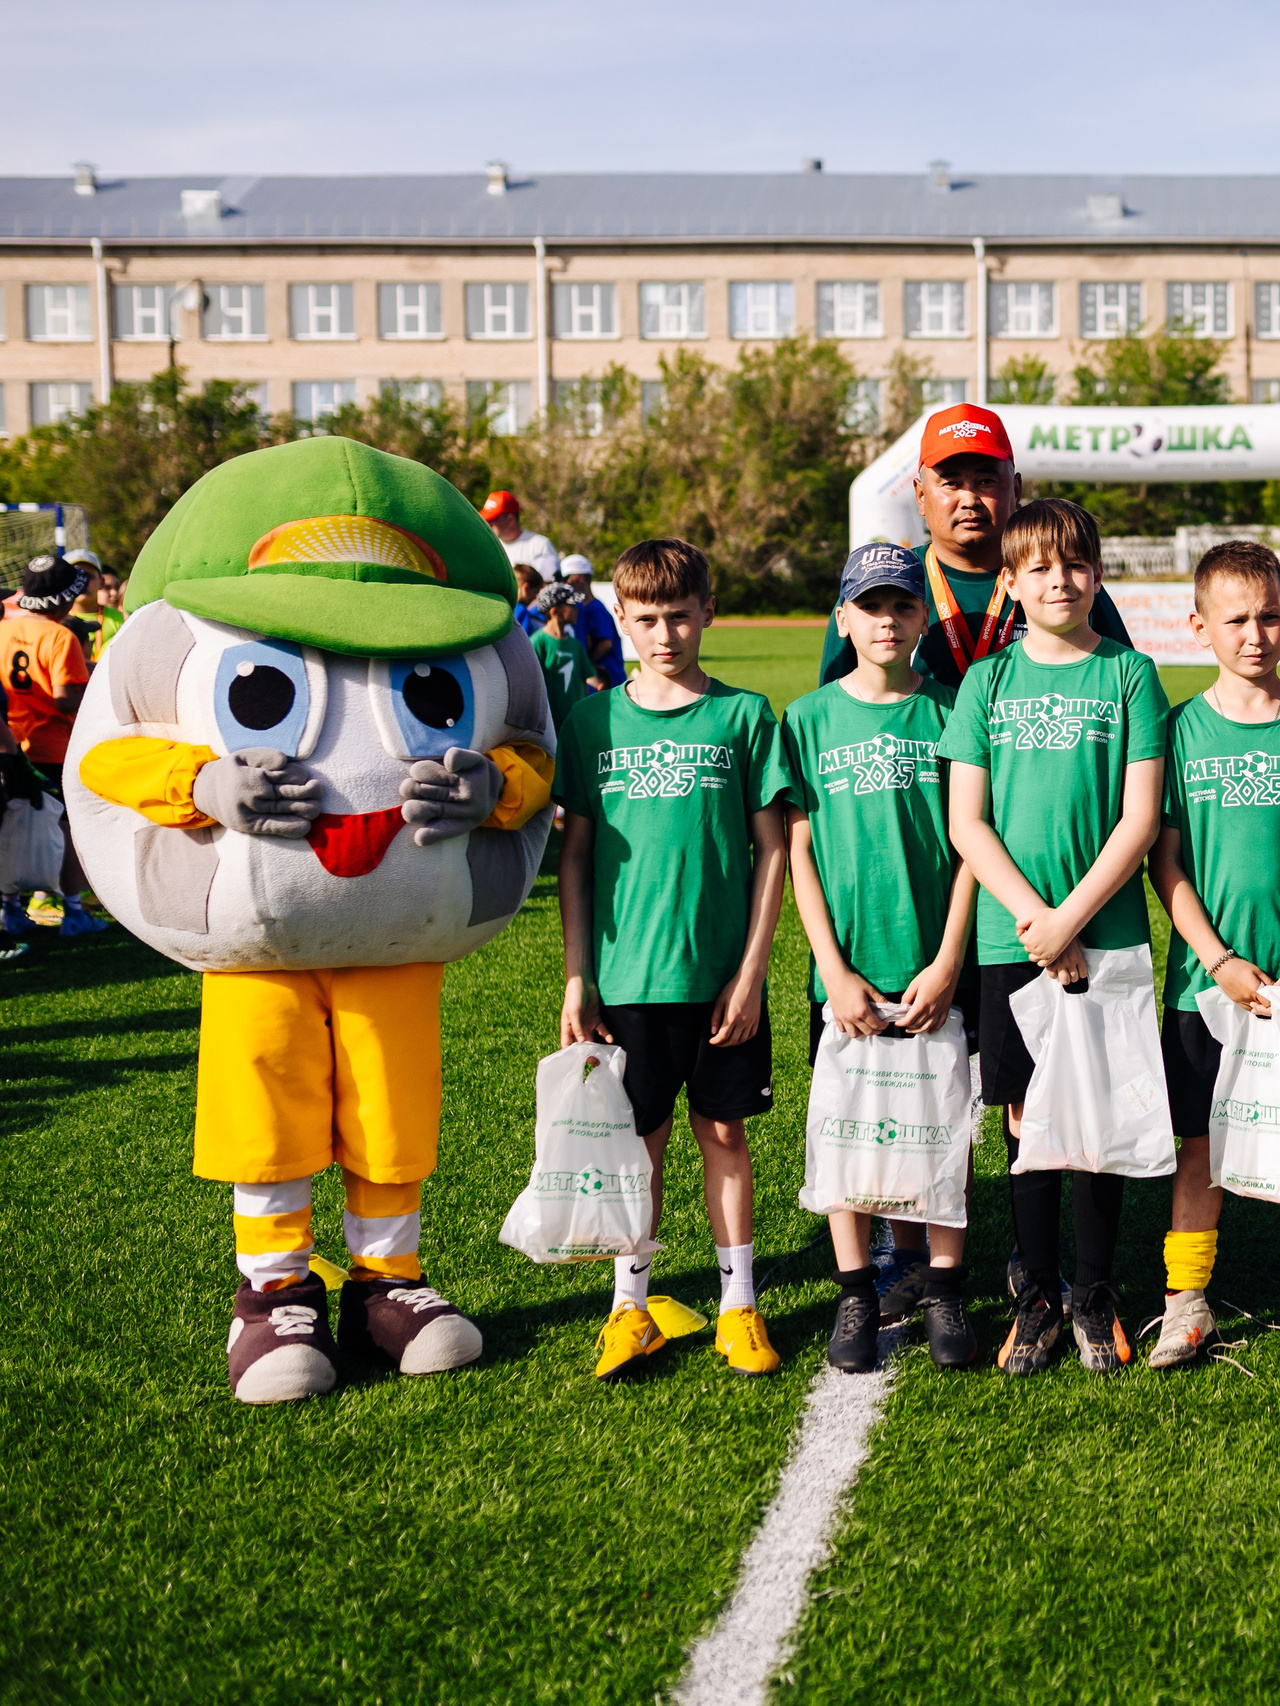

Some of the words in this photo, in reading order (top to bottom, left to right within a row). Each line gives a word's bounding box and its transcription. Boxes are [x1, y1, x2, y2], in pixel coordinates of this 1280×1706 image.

[938, 420, 991, 436] МЕТРОШКА
[953, 430, 977, 438] 2025
[861, 546, 905, 565] UFC
[19, 571, 89, 610] CONVERSE
[9, 650, 32, 690] 8
[988, 692, 1120, 724] МЕТРОШКА
[1015, 719, 1083, 750] 2025
[598, 740, 732, 774] МЕТРОШКА
[628, 766, 697, 799] 2025
[852, 760, 916, 796] 2025
[1188, 788, 1217, 798] ФЕСТИВАЛЬ
[1193, 794, 1217, 804] ДЕТСКОГО
[872, 1080, 917, 1089] ОБЕЖДАЙ!
[893, 1071, 938, 1081] ФУТБОЛОМ
[820, 1116, 952, 1146] МЕТРОШКА
